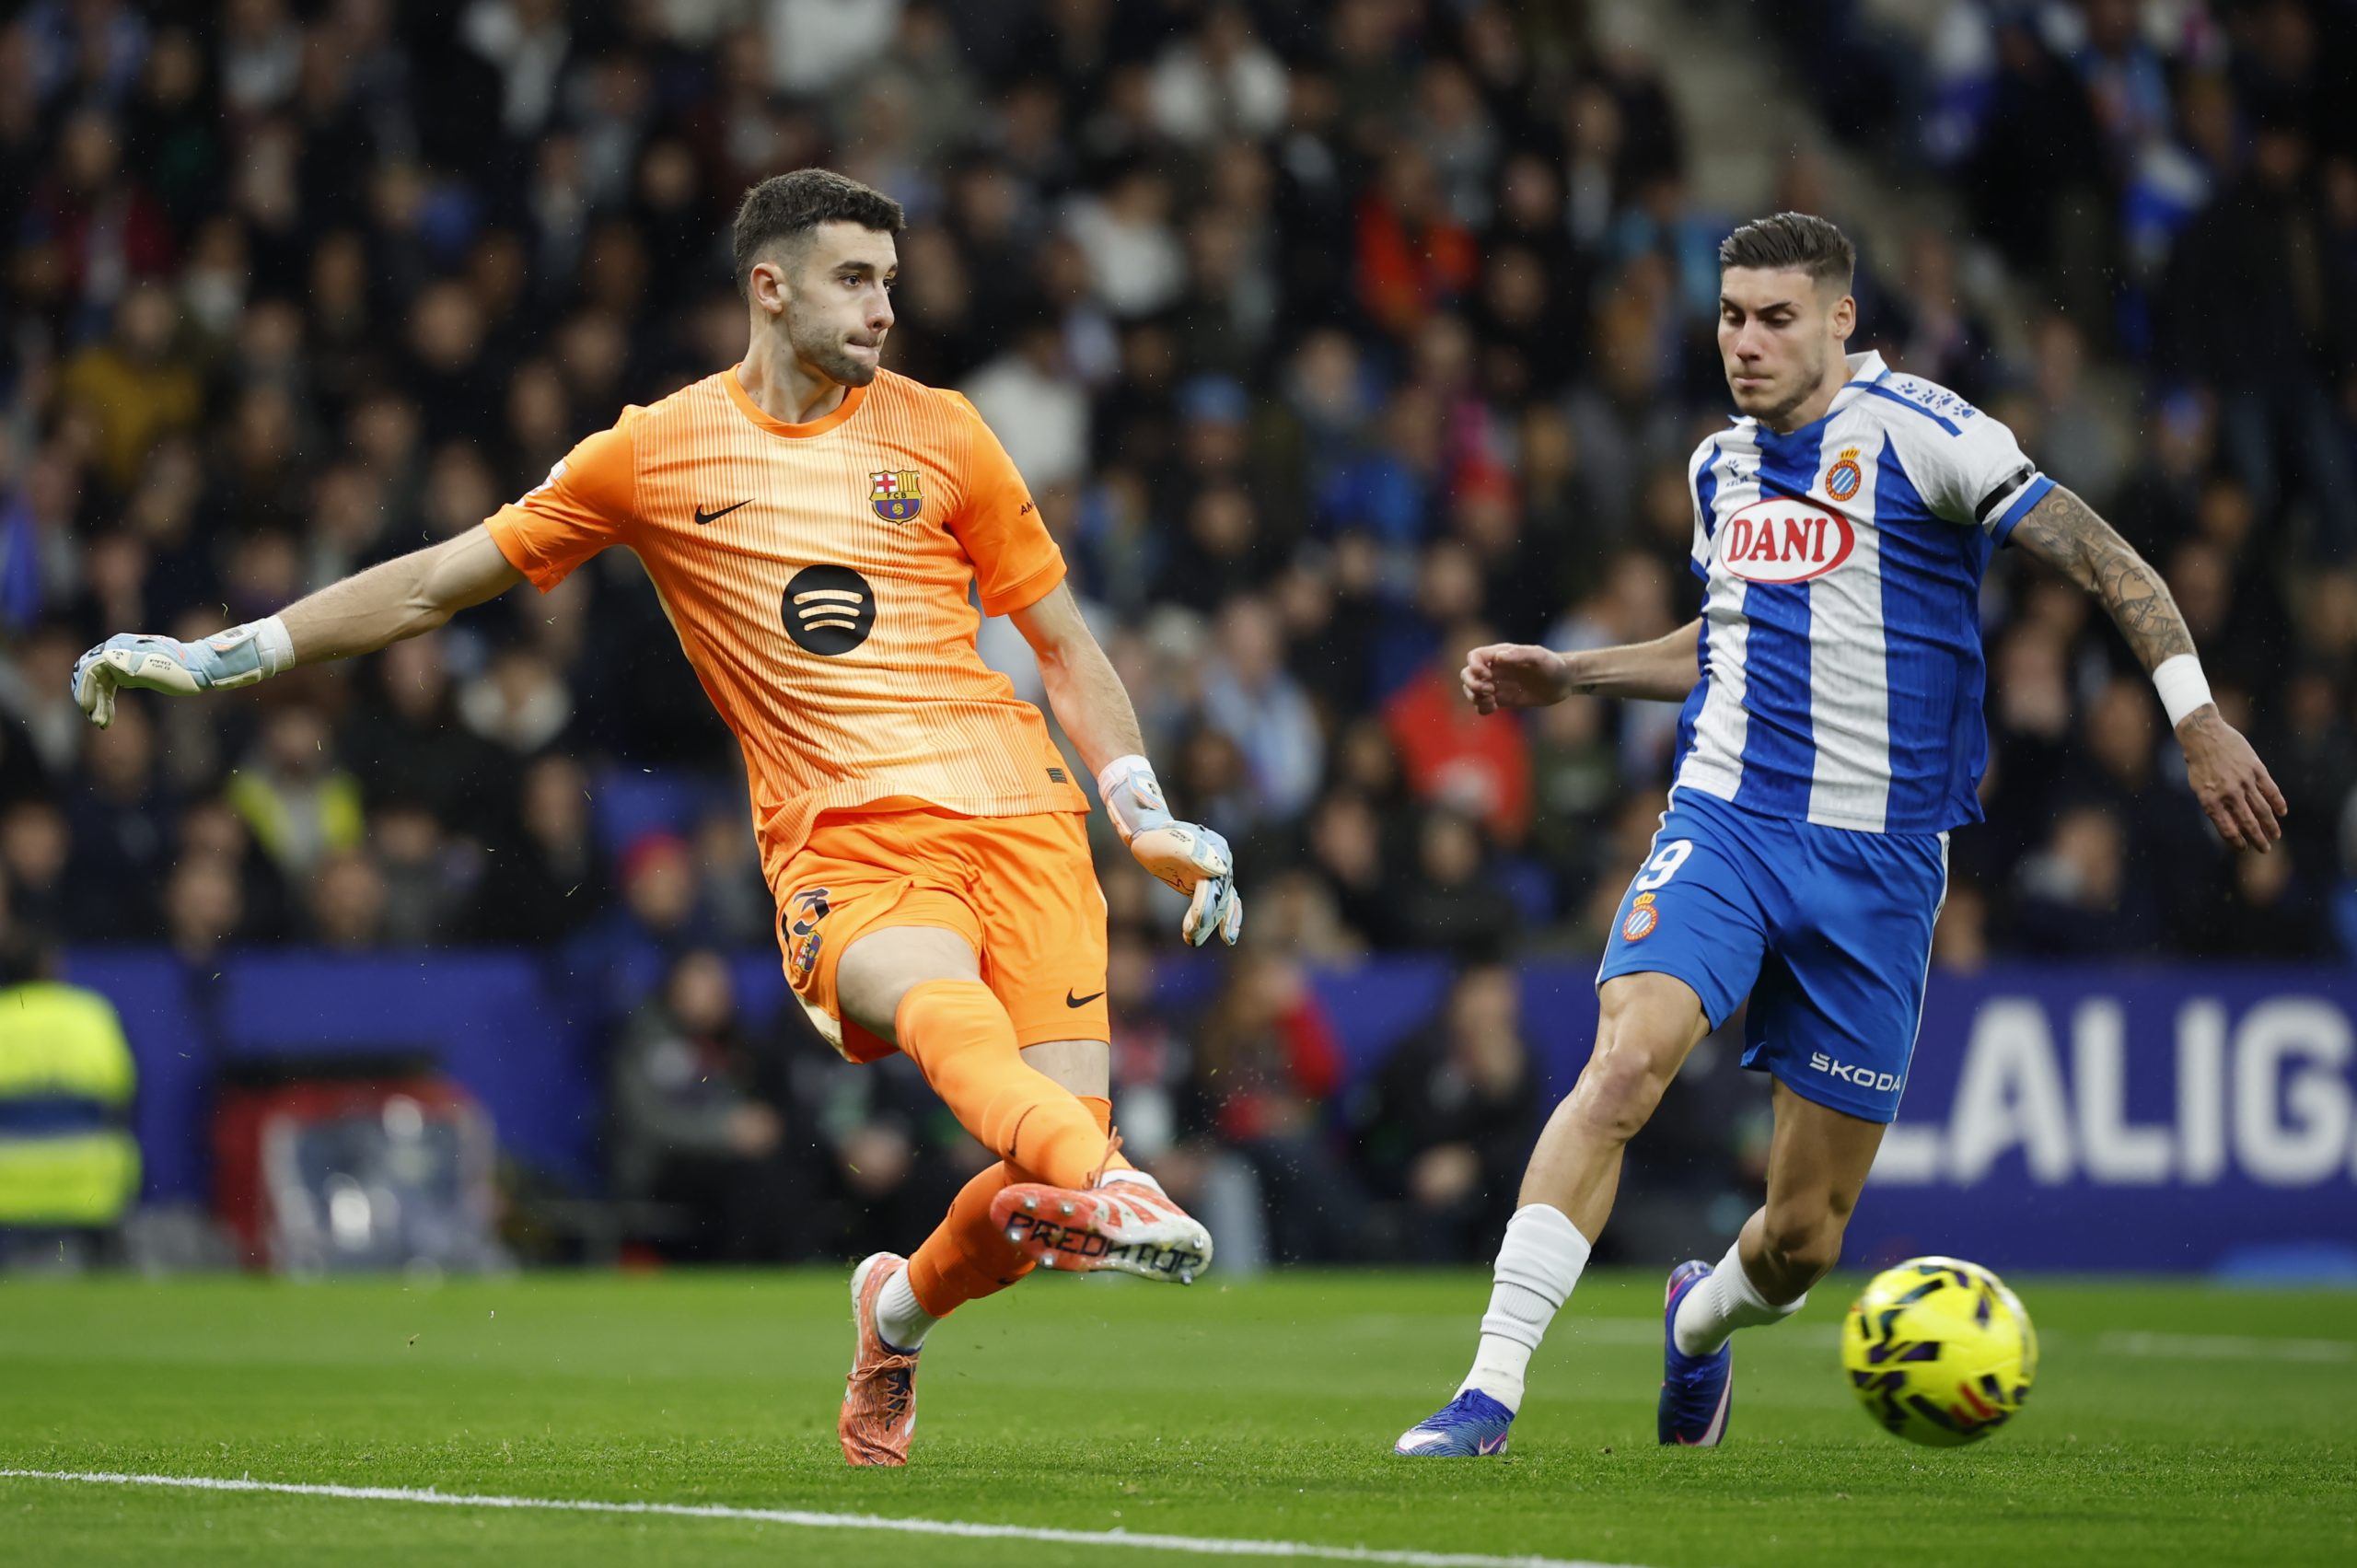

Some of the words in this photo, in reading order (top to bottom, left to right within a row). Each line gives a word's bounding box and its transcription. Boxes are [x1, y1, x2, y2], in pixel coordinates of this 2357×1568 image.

[1727, 517, 1828, 563] DANI
[1636, 839, 1693, 891] 9
[1869, 994, 2357, 1187] ALIG
